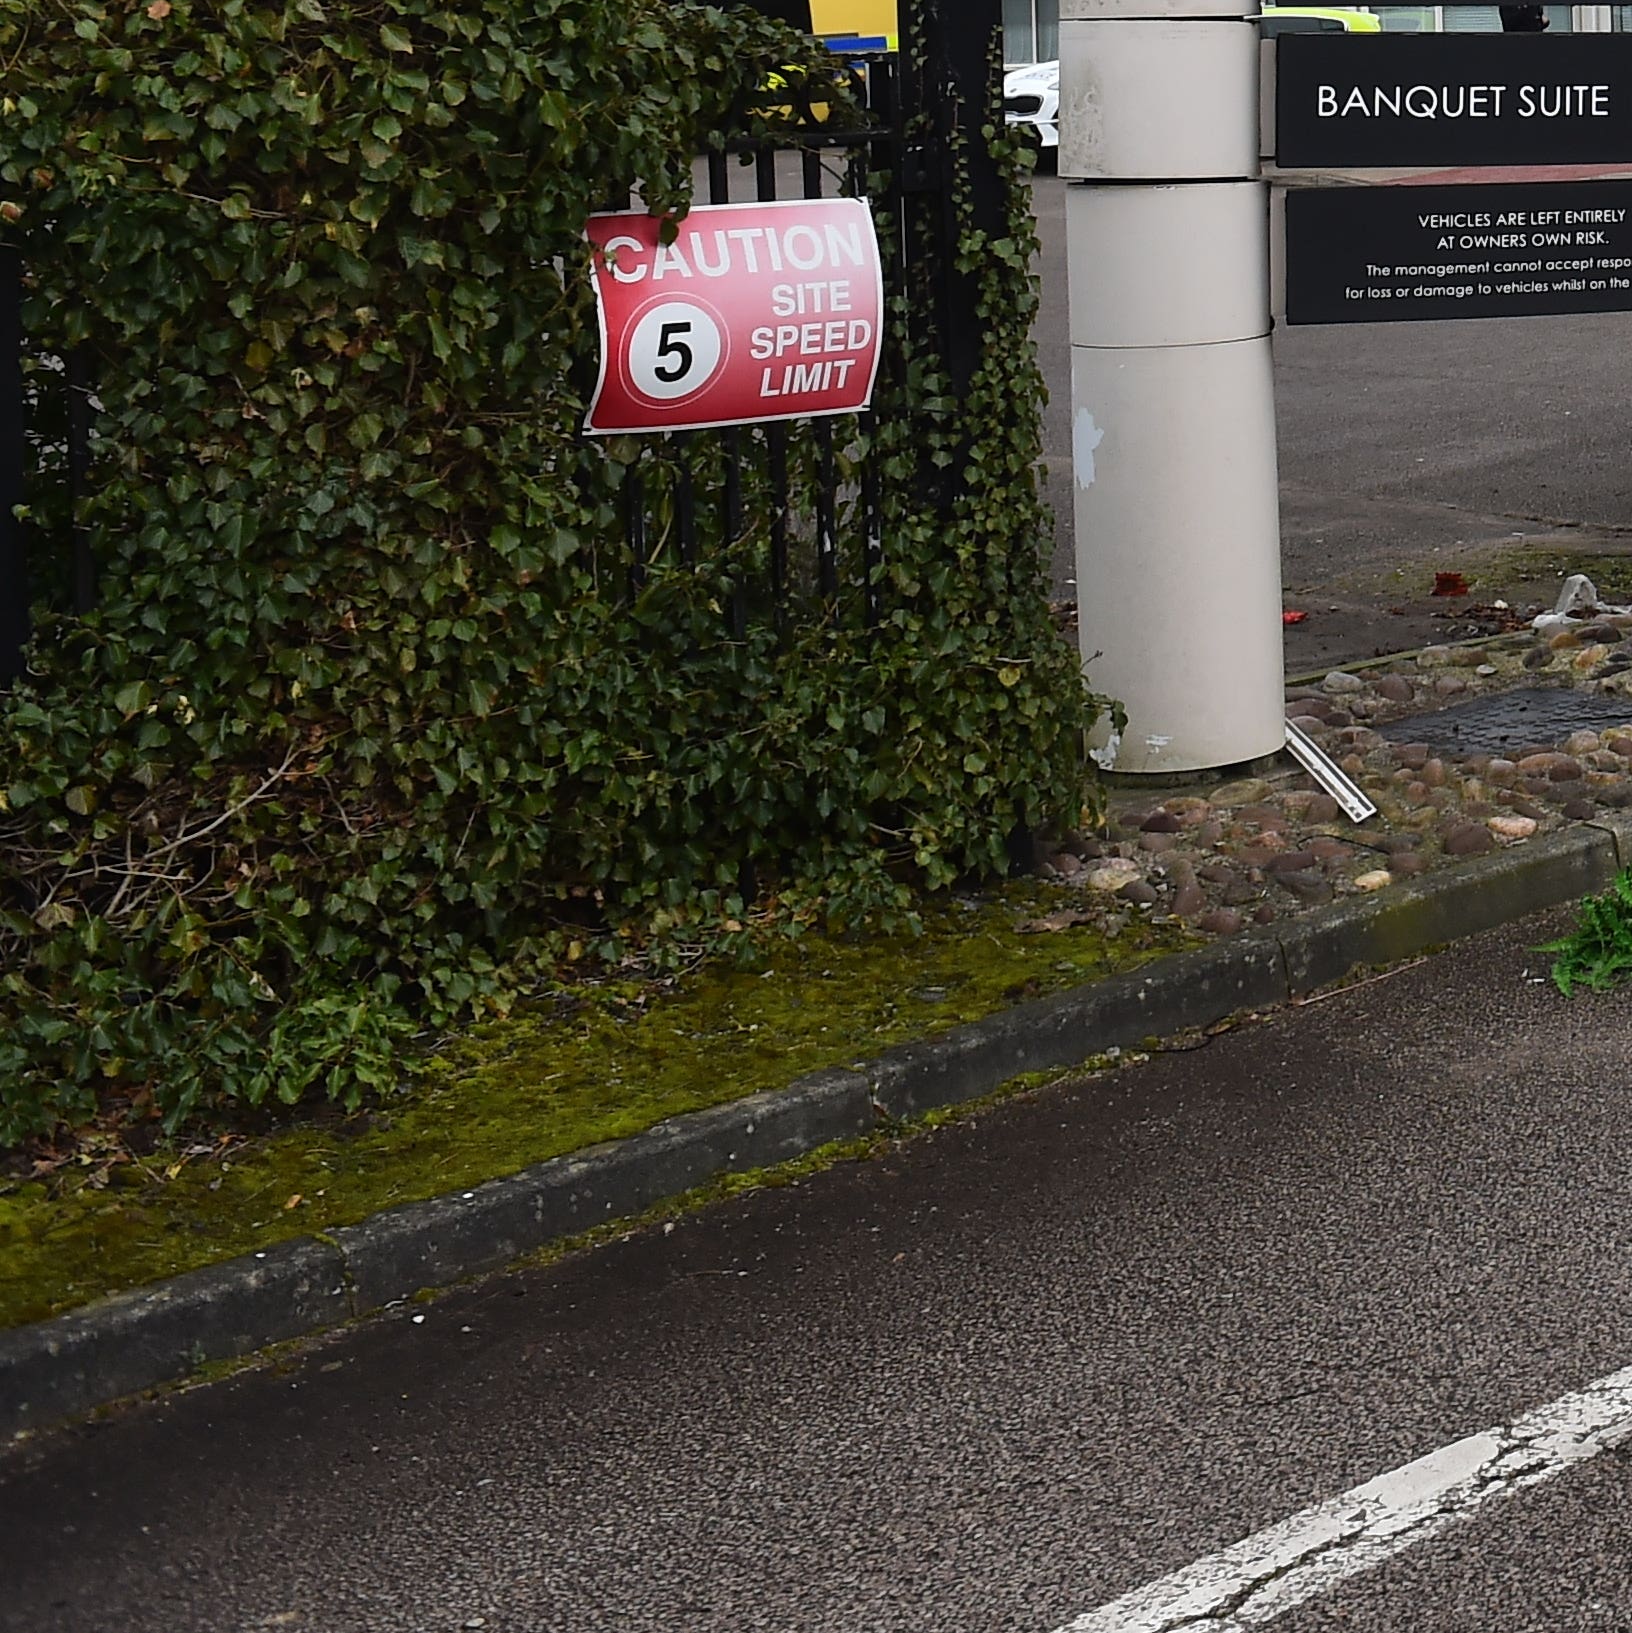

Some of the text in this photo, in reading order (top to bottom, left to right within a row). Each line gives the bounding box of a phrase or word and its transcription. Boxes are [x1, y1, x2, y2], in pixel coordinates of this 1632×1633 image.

[1318, 85, 1609, 118] BANQUET SUITE
[1418, 209, 1626, 229] VEHICLES ARE LEFT ENTIRELY
[604, 223, 865, 284] CAUTION
[1436, 231, 1609, 249] AT OWNERS OWN RISK.
[1366, 265, 1390, 276] The
[1394, 262, 1489, 277] management
[1493, 259, 1541, 273] cannot
[1545, 257, 1593, 271] accept
[772, 280, 851, 317] SITE
[1345, 286, 1364, 299] for
[1368, 286, 1392, 298] loss
[1395, 287, 1410, 297] or
[1413, 285, 1473, 298] damage
[1478, 283, 1492, 295] to
[1495, 281, 1548, 294] vehicles
[1552, 279, 1586, 291] whilst
[1590, 280, 1606, 290] on
[1610, 277, 1630, 288] the
[654, 321, 693, 383] 5
[750, 319, 871, 360] SPEED
[760, 359, 855, 397] LIMIT
